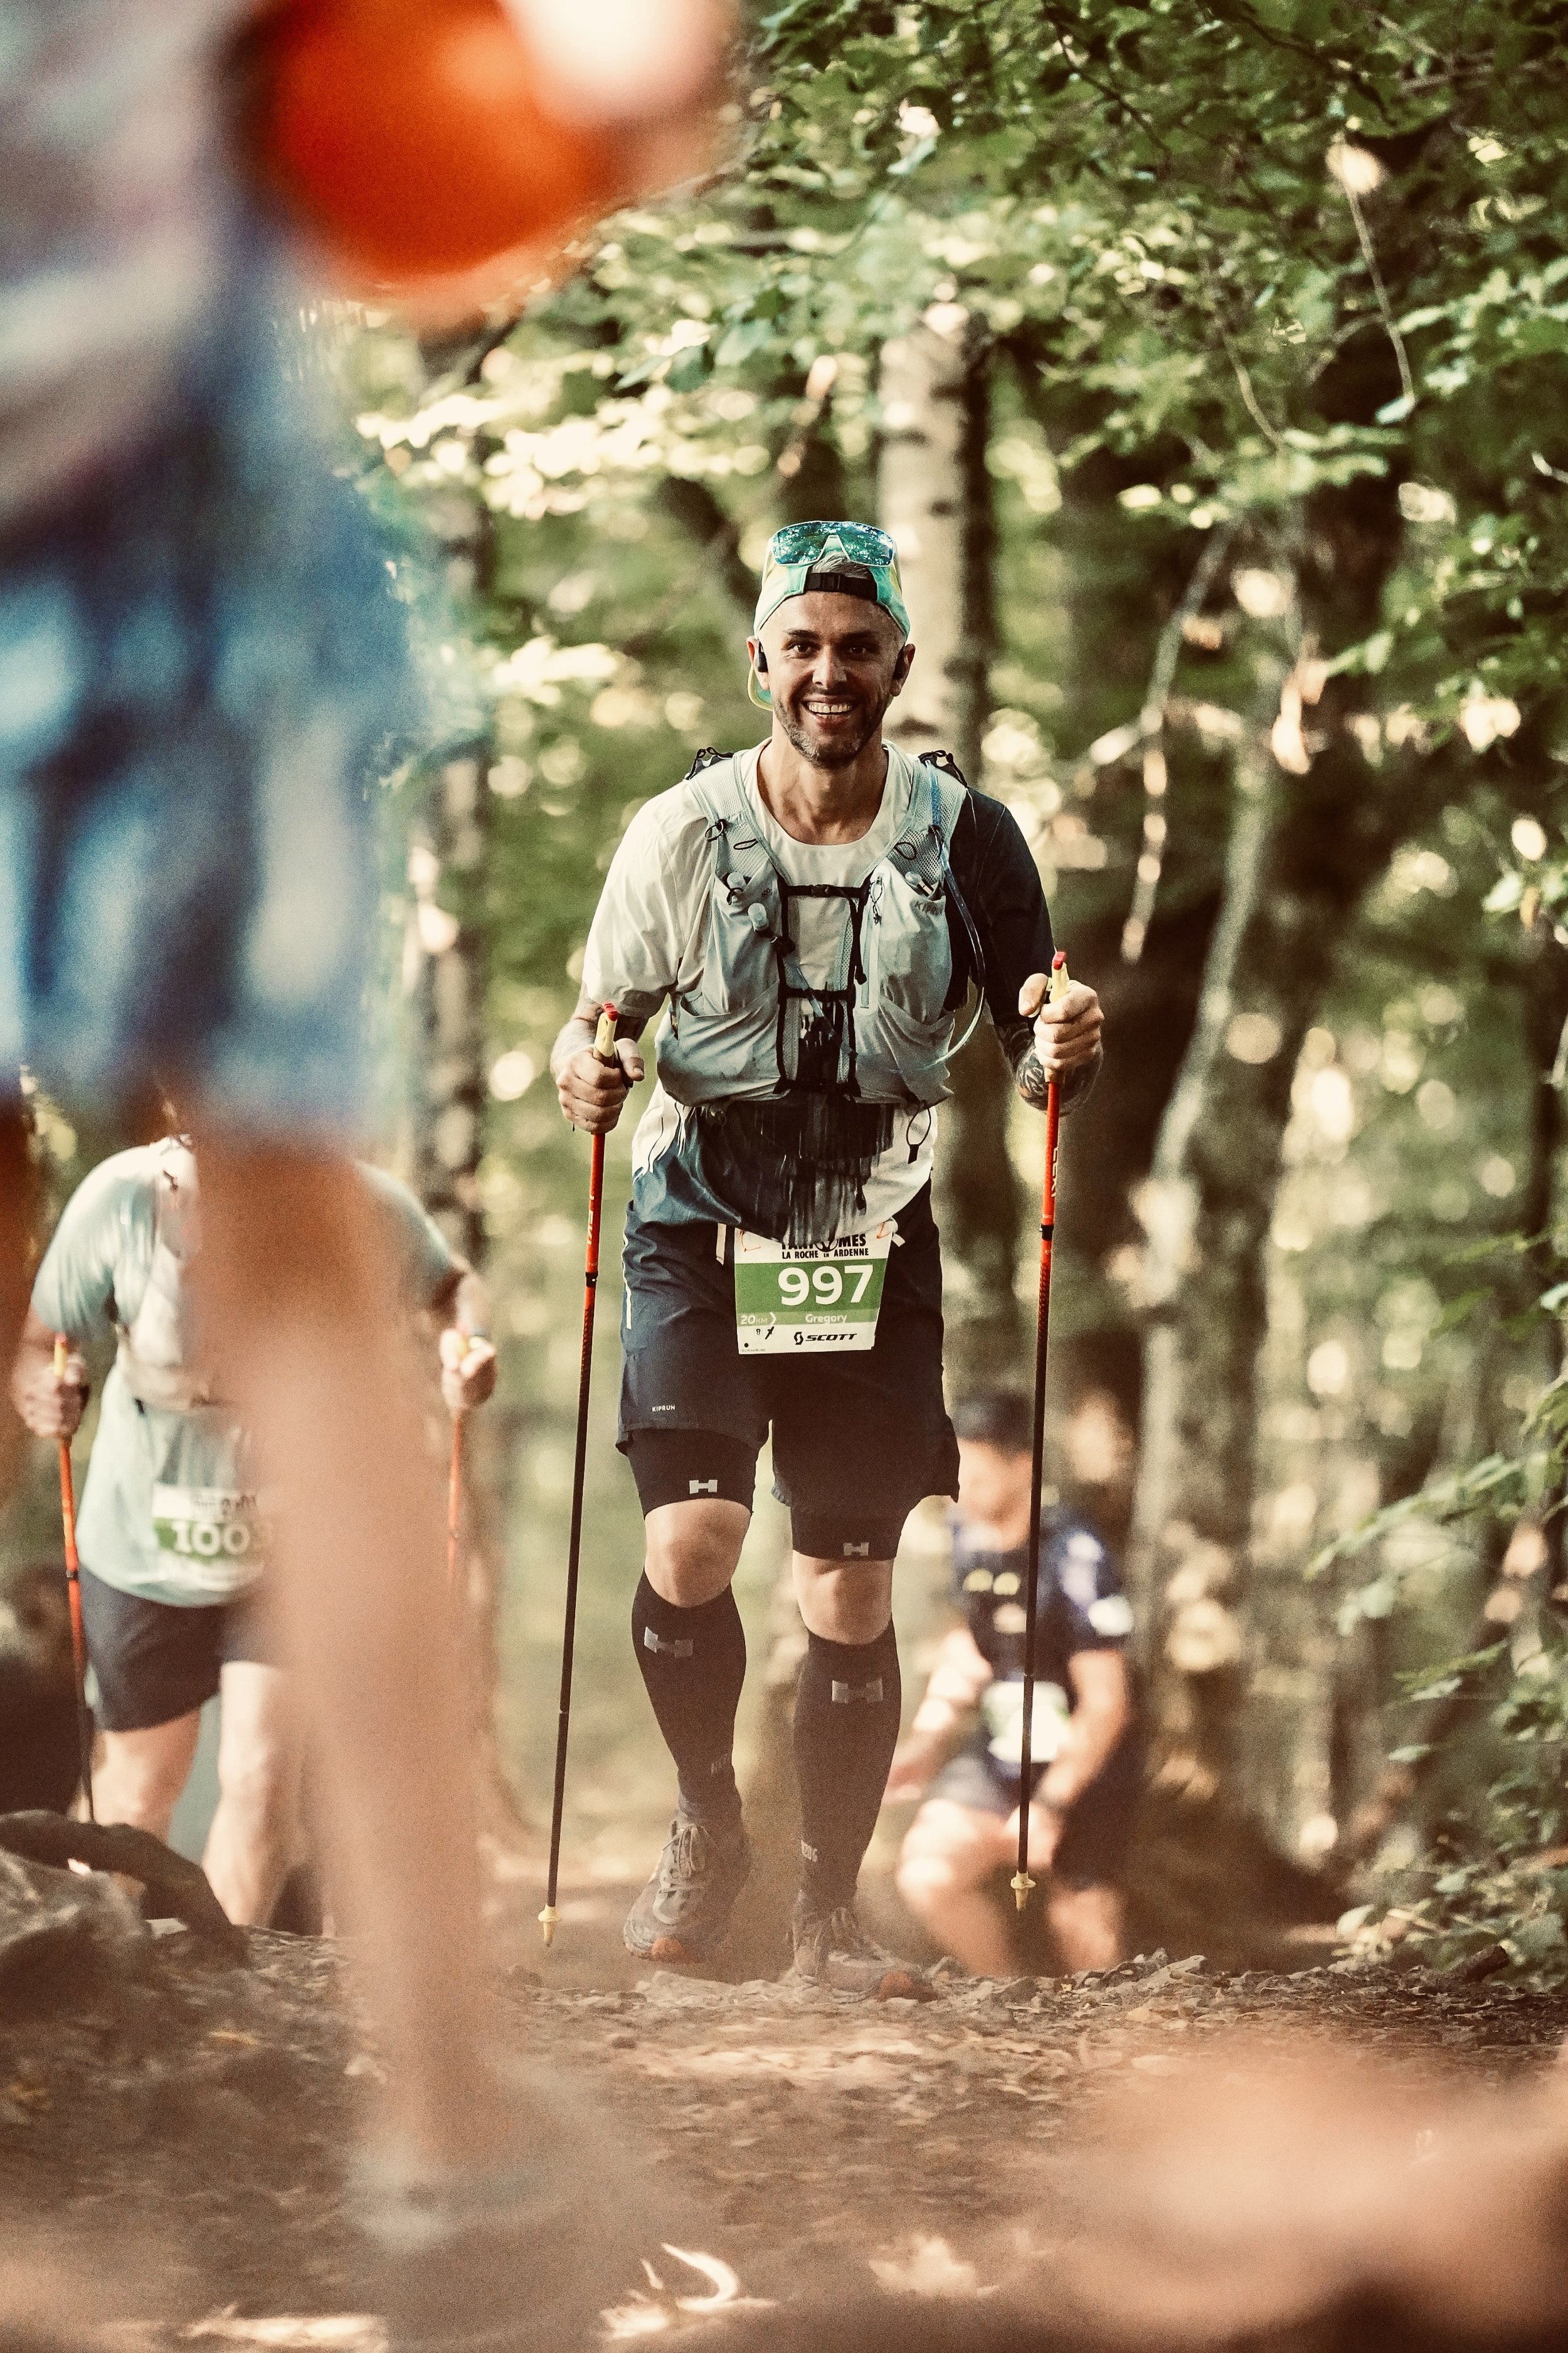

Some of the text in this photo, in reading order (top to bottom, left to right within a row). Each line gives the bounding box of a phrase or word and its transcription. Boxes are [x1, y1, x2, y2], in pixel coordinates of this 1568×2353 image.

[795, 1250, 818, 1259] ROCHE
[834, 1248, 869, 1257] ARDENNE
[778, 1265, 873, 1306] 997
[805, 1314, 847, 1324] Gregory
[172, 1519, 275, 1556] 100
